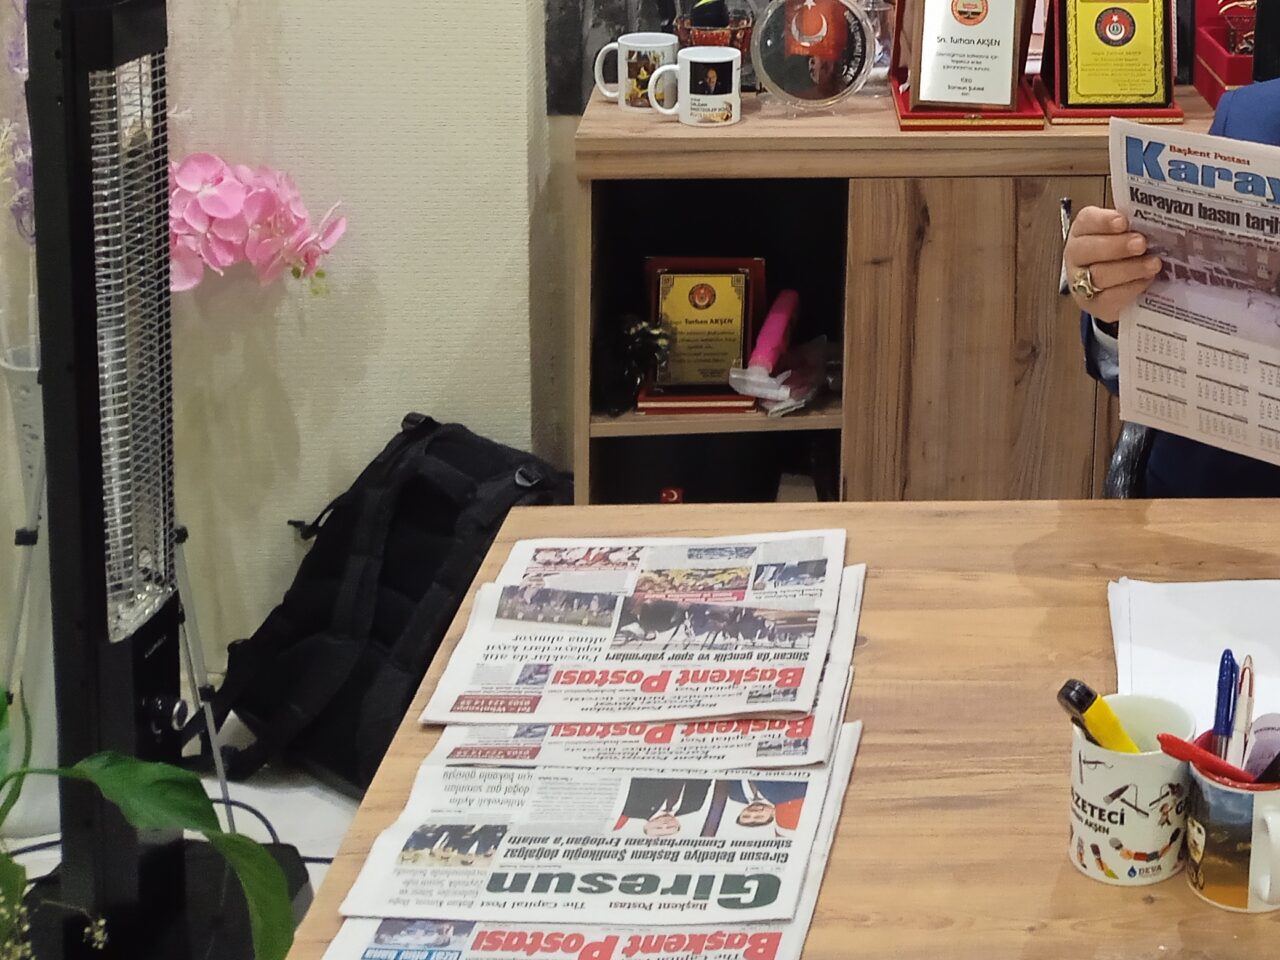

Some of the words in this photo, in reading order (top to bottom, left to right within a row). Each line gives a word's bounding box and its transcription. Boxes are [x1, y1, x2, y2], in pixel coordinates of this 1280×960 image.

[1169, 144, 1211, 158] Başkent
[1213, 151, 1250, 166] Postası
[1129, 186, 1194, 217] Karayazı
[1197, 201, 1241, 227] basın
[605, 651, 666, 662] yatırımları
[668, 651, 695, 662] spor
[713, 651, 754, 662] gençlik
[757, 651, 810, 662] Sincan'da
[550, 669, 673, 694] Postası
[675, 666, 806, 689] Başkent
[680, 715, 815, 739] Başkent
[551, 723, 677, 745] Postası
[550, 835, 621, 849] Erdoğan'a
[624, 837, 727, 850] Cumhurbaşkanı
[503, 847, 560, 862] doğalgaz
[562, 848, 627, 863] Şenlikoğlu
[630, 850, 680, 863] Başkanı
[683, 850, 737, 863] Belediye
[740, 851, 789, 863] Giresun
[1138, 865, 1162, 876] DEVA
[486, 872, 782, 910] Giresun
[479, 900, 507, 910] Post
[511, 900, 558, 910] Capital
[562, 901, 586, 910] The
[608, 900, 654, 911] Postası
[658, 900, 708, 912] Başkent
[470, 930, 620, 960] Postası
[621, 930, 783, 960] Başkent
